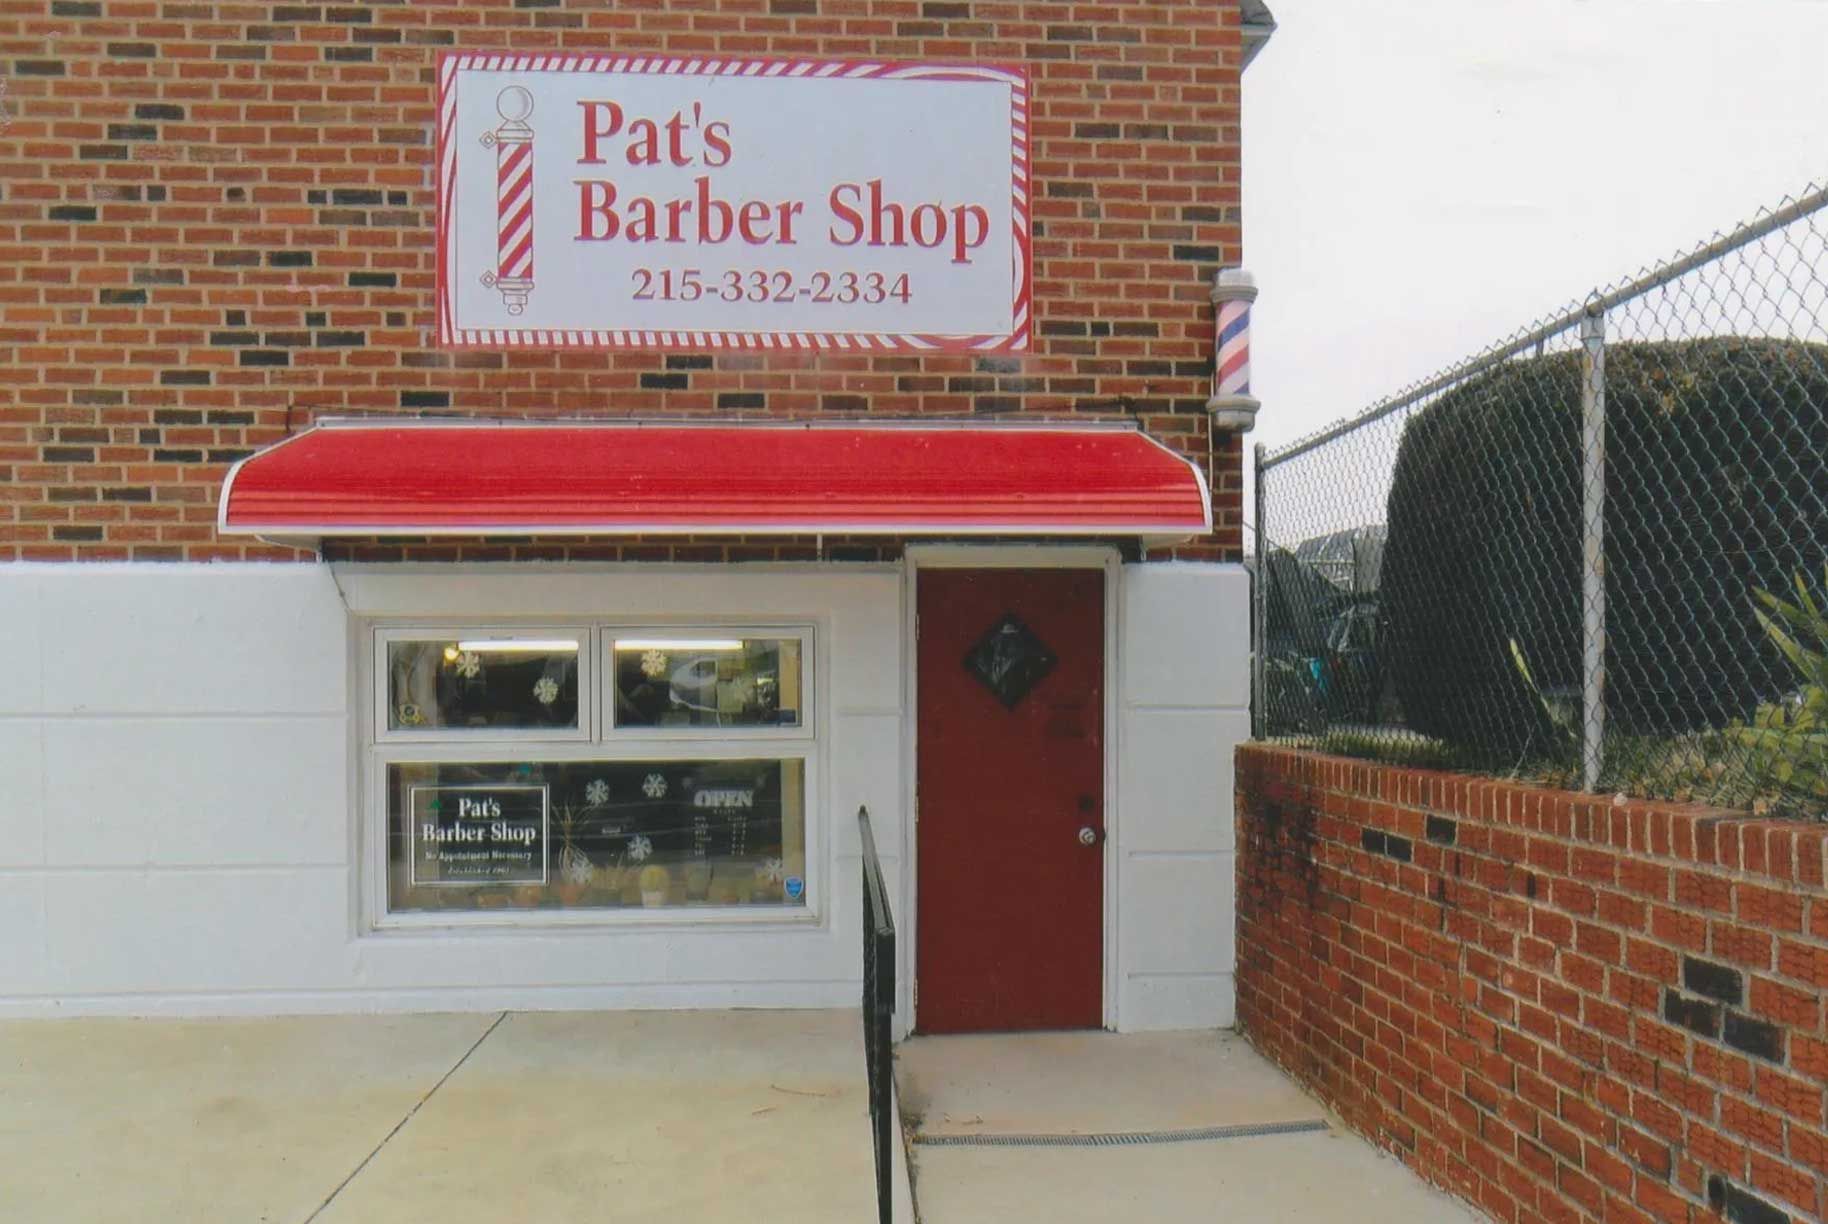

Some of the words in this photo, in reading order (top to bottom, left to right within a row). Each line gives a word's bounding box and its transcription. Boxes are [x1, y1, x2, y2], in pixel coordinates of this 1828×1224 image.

[576, 100, 732, 167] Pat's
[573, 176, 804, 245] Barber
[828, 178, 990, 264] Shop
[631, 268, 913, 304] 215-332-2334
[459, 797, 501, 817] Pat's
[694, 790, 753, 807] OPEN
[422, 821, 485, 841] Barber
[491, 820, 536, 845] Shop
